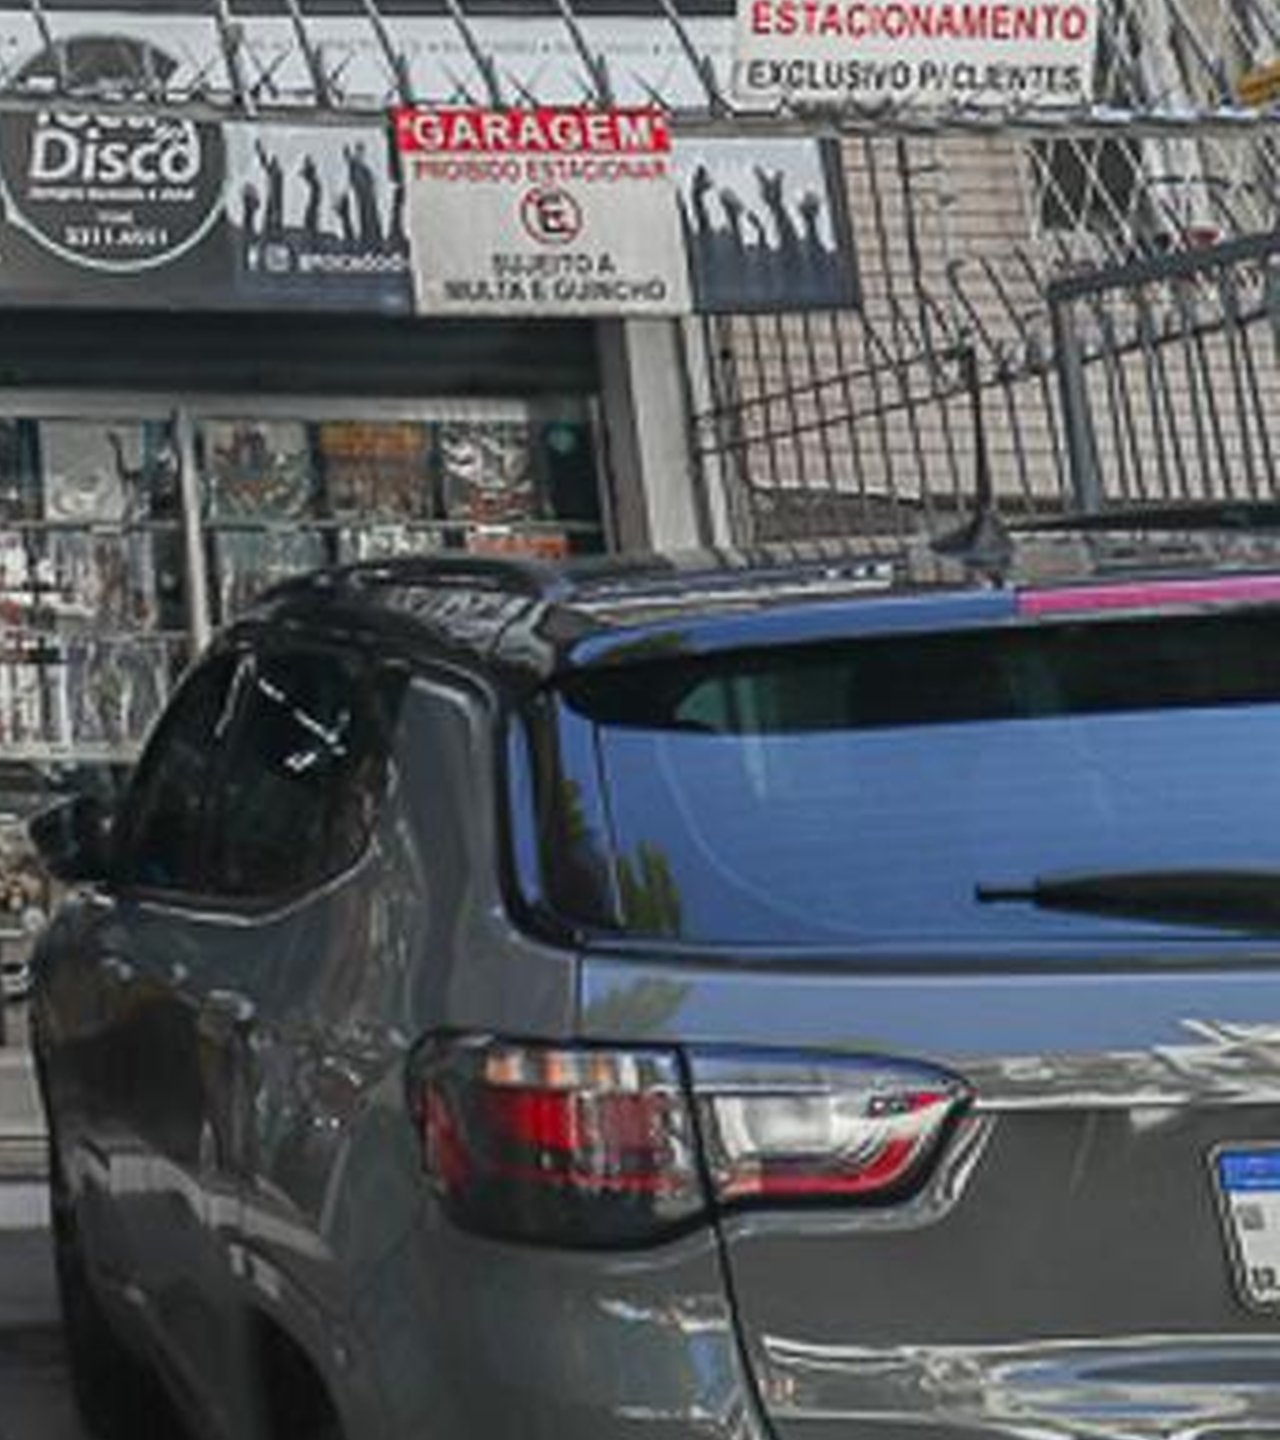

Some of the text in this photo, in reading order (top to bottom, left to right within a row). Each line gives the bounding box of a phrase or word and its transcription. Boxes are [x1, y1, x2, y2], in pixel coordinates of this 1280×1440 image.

[751, 0, 1088, 41] ESTACIONAMENTO
[746, 59, 912, 92] EXCLUSIVO
[952, 62, 1083, 96] CLIENTES
[414, 113, 653, 150] GARAGEM
[28, 127, 201, 183] Disco
[526, 160, 667, 182] ESTACIONAR
[493, 254, 617, 276] SUJEITO A
[444, 280, 526, 301] MULTA
[554, 277, 667, 302] GUINCHO
